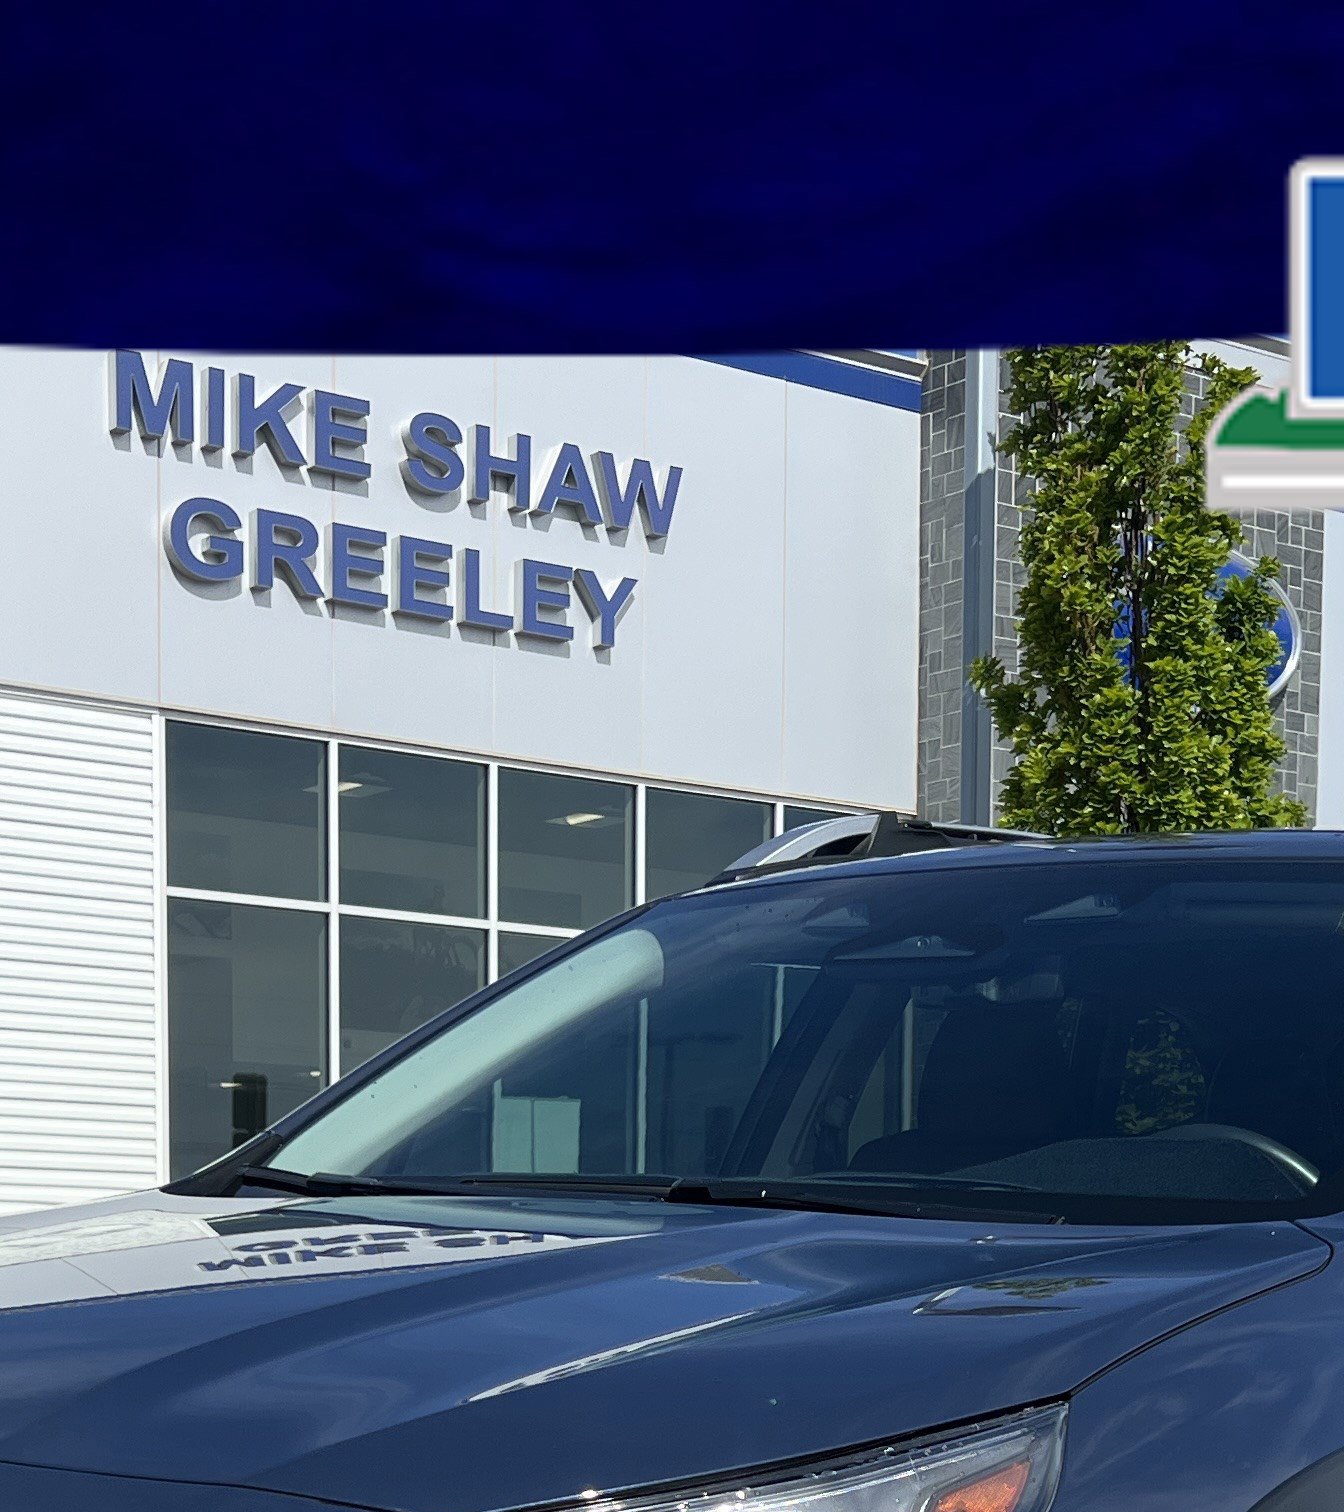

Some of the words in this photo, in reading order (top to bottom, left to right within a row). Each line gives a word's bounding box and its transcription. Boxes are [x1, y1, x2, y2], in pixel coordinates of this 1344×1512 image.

[109, 348, 372, 480] MIKE
[401, 411, 684, 541] SHAW
[163, 496, 638, 651] GREELEY
